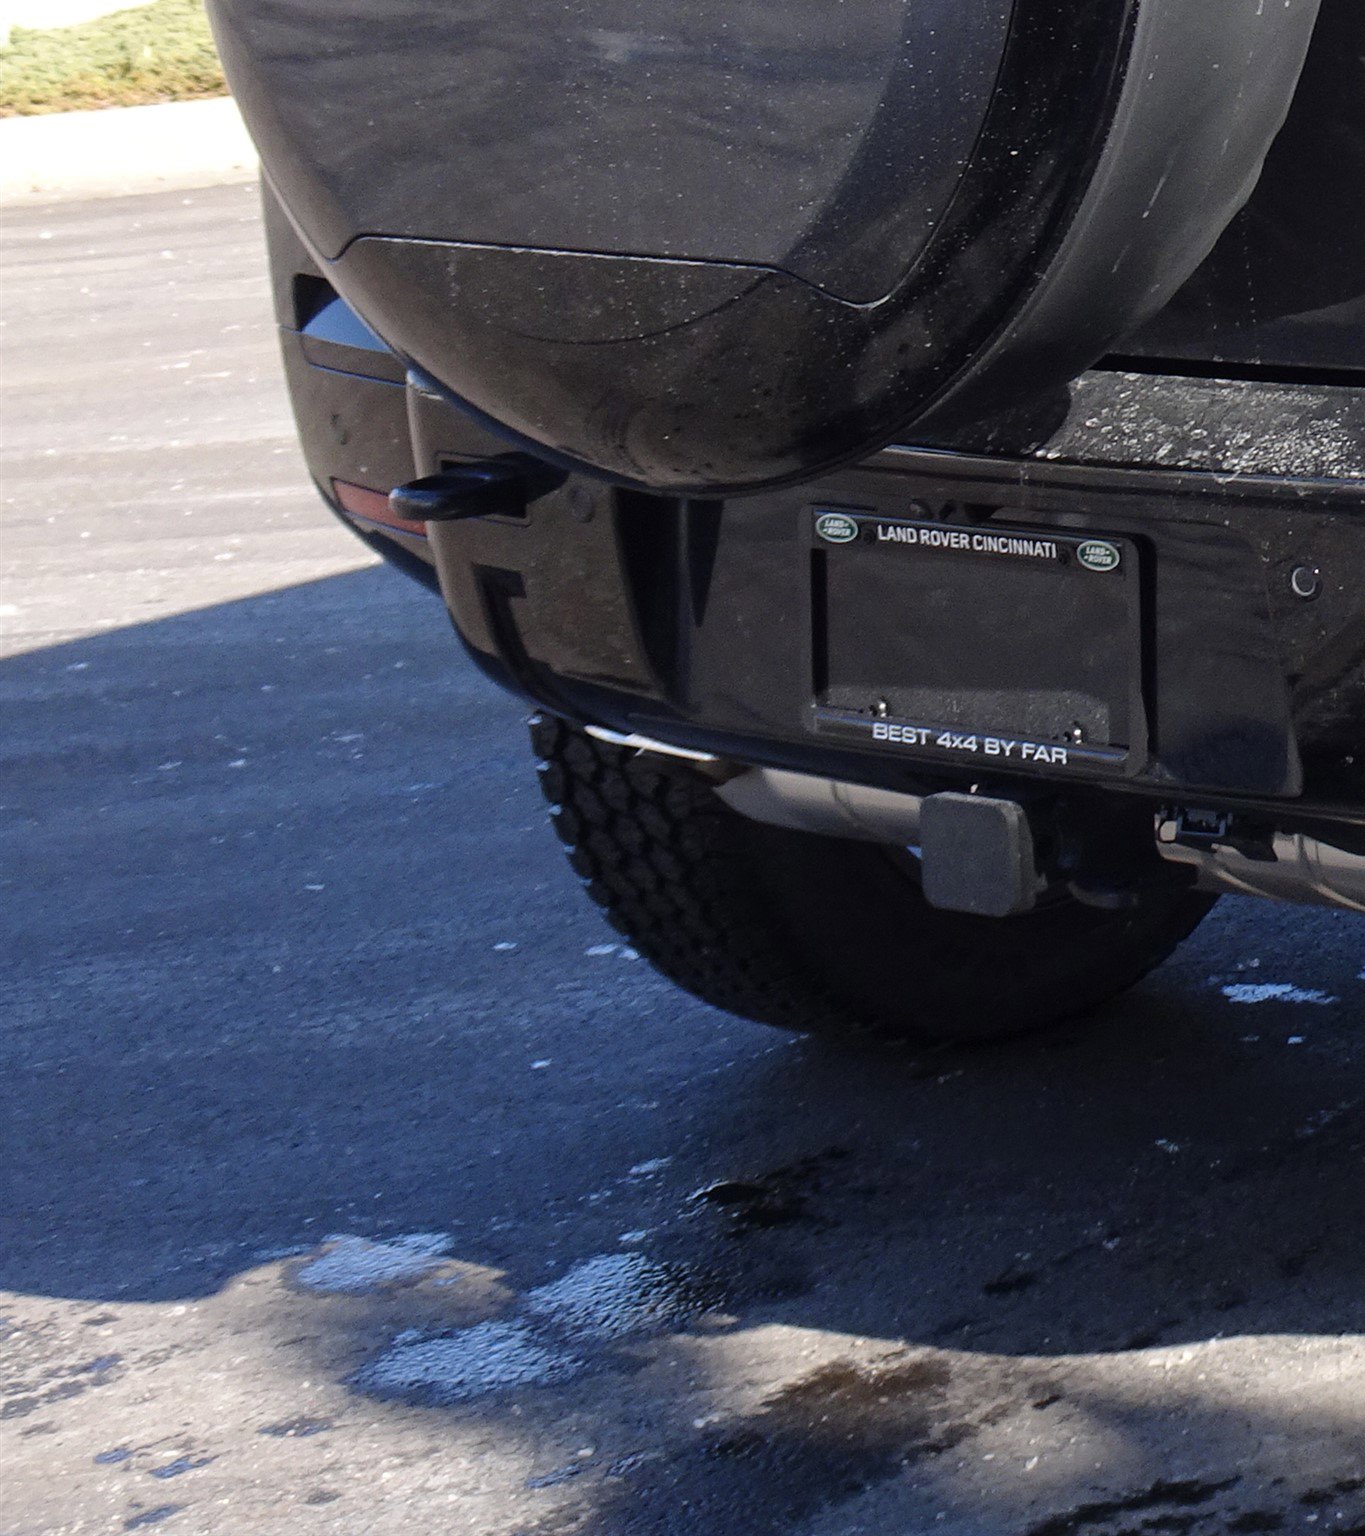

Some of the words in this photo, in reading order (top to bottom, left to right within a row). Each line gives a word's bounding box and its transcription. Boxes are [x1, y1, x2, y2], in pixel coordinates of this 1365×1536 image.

[878, 524, 917, 544] LAND
[920, 529, 970, 550] ROVER
[972, 534, 1057, 558] CINCINNATI
[873, 722, 931, 744] BEST
[936, 731, 978, 752] 4x4
[985, 736, 1016, 758] BY
[1021, 742, 1068, 765] FAR
